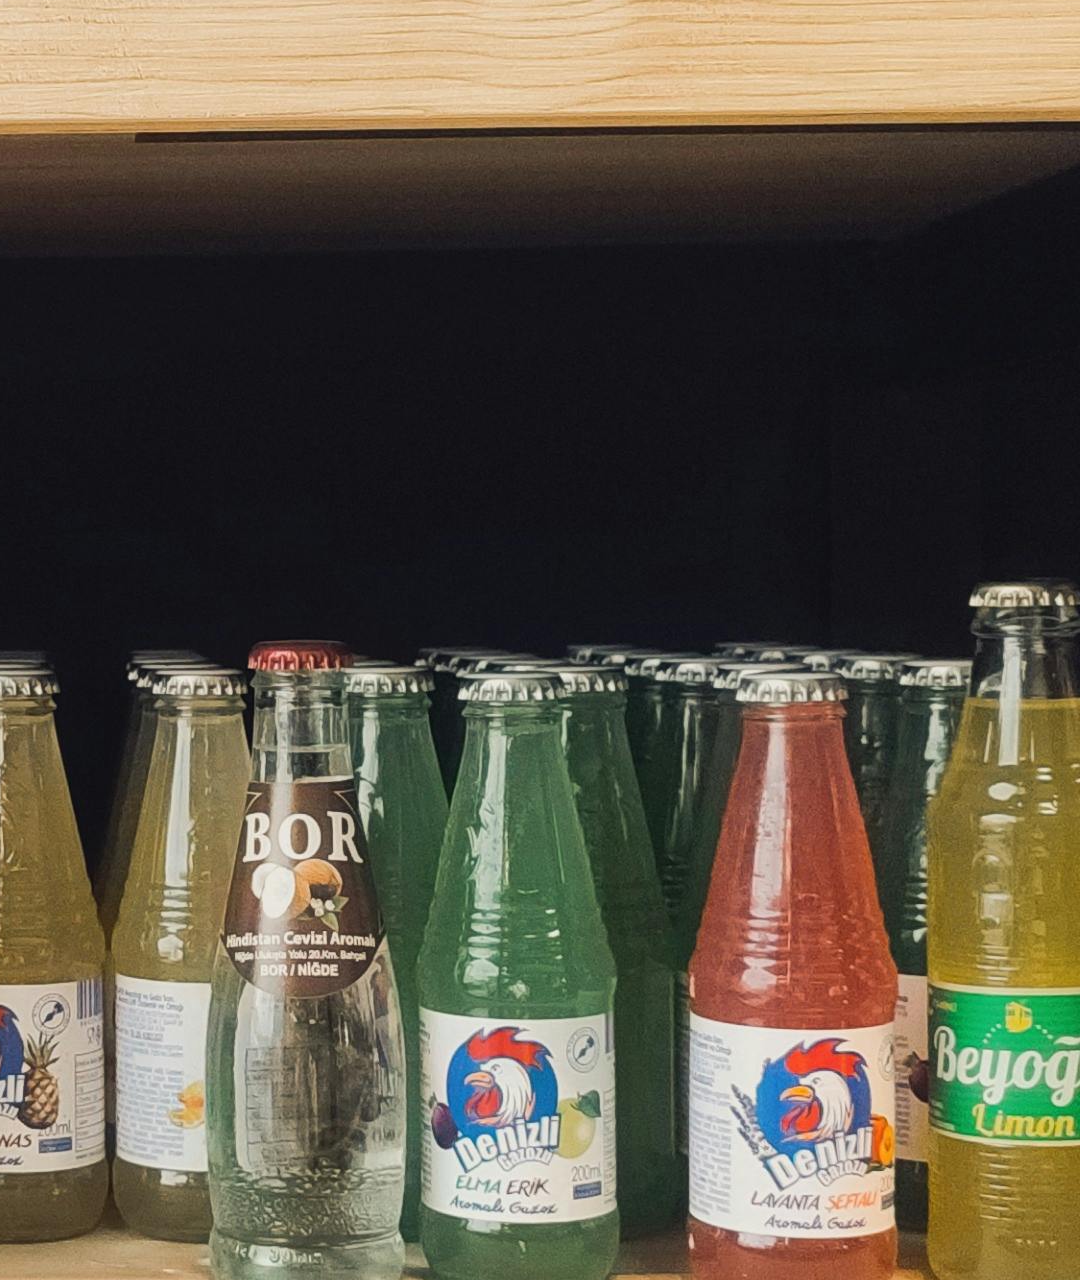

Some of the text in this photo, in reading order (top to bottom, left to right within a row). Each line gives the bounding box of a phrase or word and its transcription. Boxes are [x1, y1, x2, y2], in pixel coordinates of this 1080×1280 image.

[242, 810, 363, 863] BOR
[226, 932, 280, 948] Hindistan
[284, 930, 328, 946] Cevizi
[288, 949, 307, 960] Yolu
[260, 964, 288, 977] BOR
[297, 961, 339, 977] NİĞDE
[972, 1103, 1076, 1137] Limon
[453, 1113, 562, 1173] Denizli
[765, 1127, 874, 1190] Denizli
[455, 1174, 501, 1193] ELMA
[751, 1190, 821, 1211] LAVANTA
